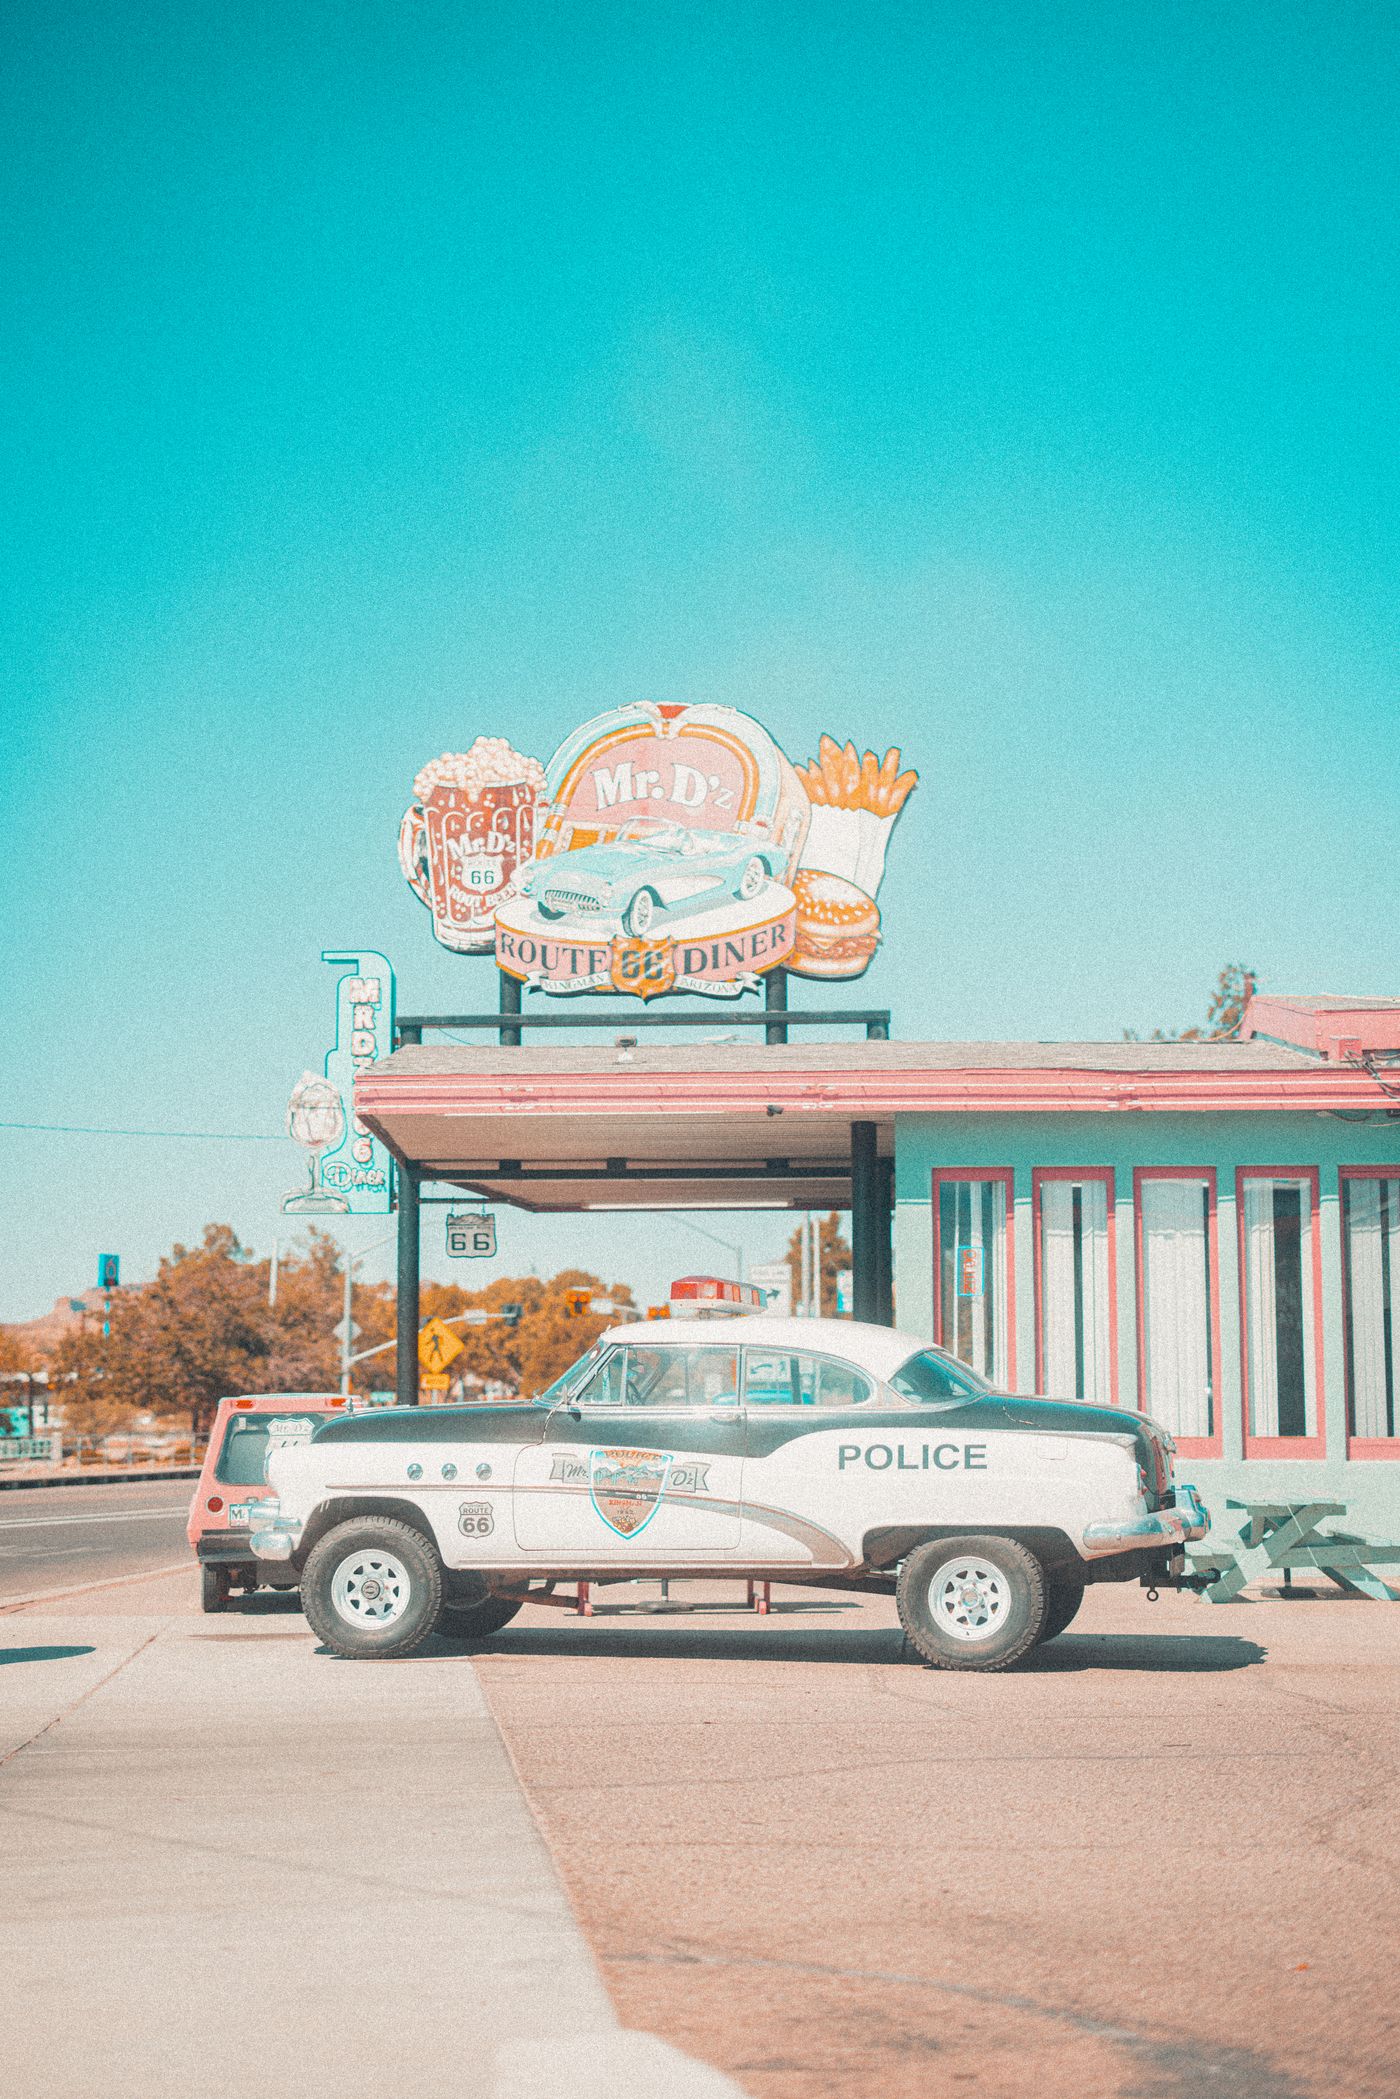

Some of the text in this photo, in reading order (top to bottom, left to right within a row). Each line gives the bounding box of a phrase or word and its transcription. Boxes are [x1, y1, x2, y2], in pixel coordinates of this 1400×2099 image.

[589, 760, 736, 811] Mr. D'z
[471, 870, 495, 885] 66
[501, 924, 786, 979] ROUTE 66 DINER
[451, 1232, 490, 1251] 66
[838, 1443, 988, 1471] POLICE
[566, 1463, 589, 1478] Mr.
[462, 1517, 490, 1533] 66
